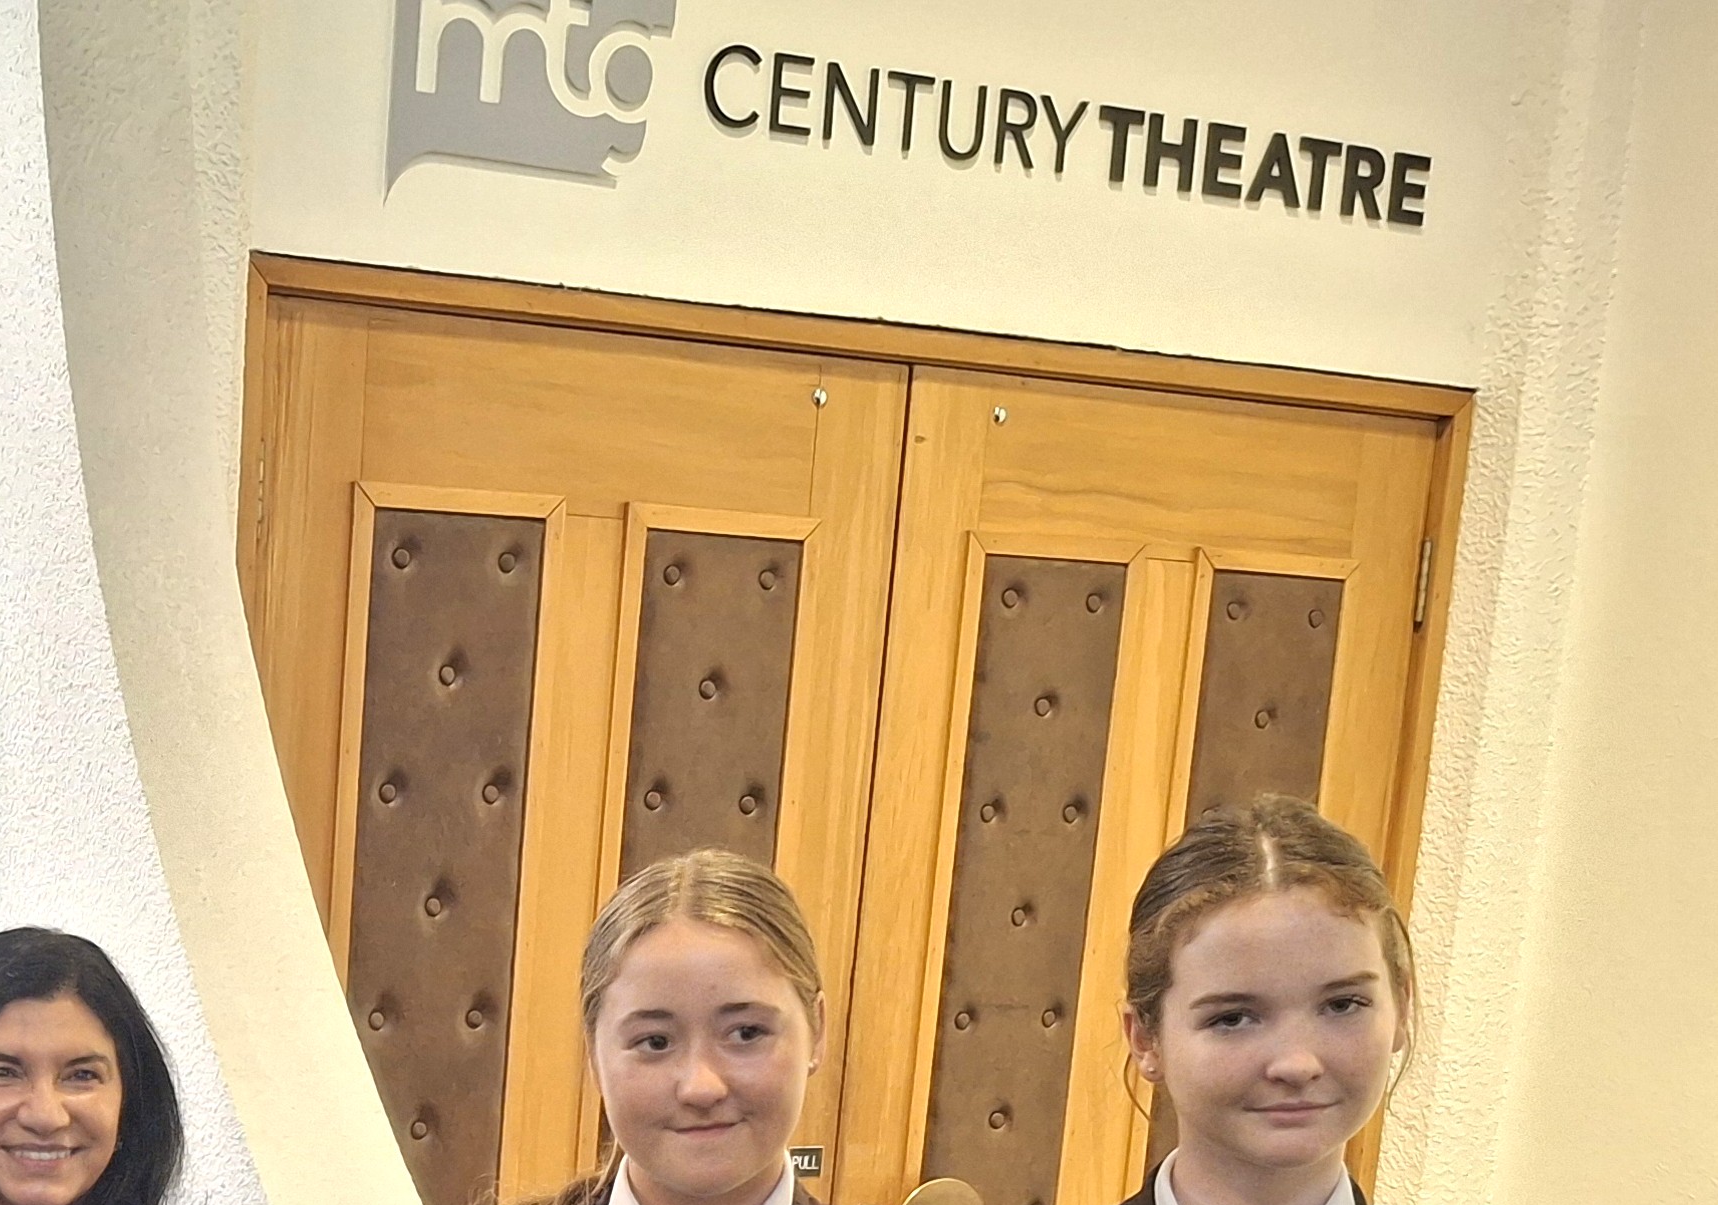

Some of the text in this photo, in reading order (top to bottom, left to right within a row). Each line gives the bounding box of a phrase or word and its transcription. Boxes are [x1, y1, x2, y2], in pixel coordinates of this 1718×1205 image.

[703, 43, 1433, 227] CENTURY THEATRE
[792, 1155, 820, 1170] PULL
